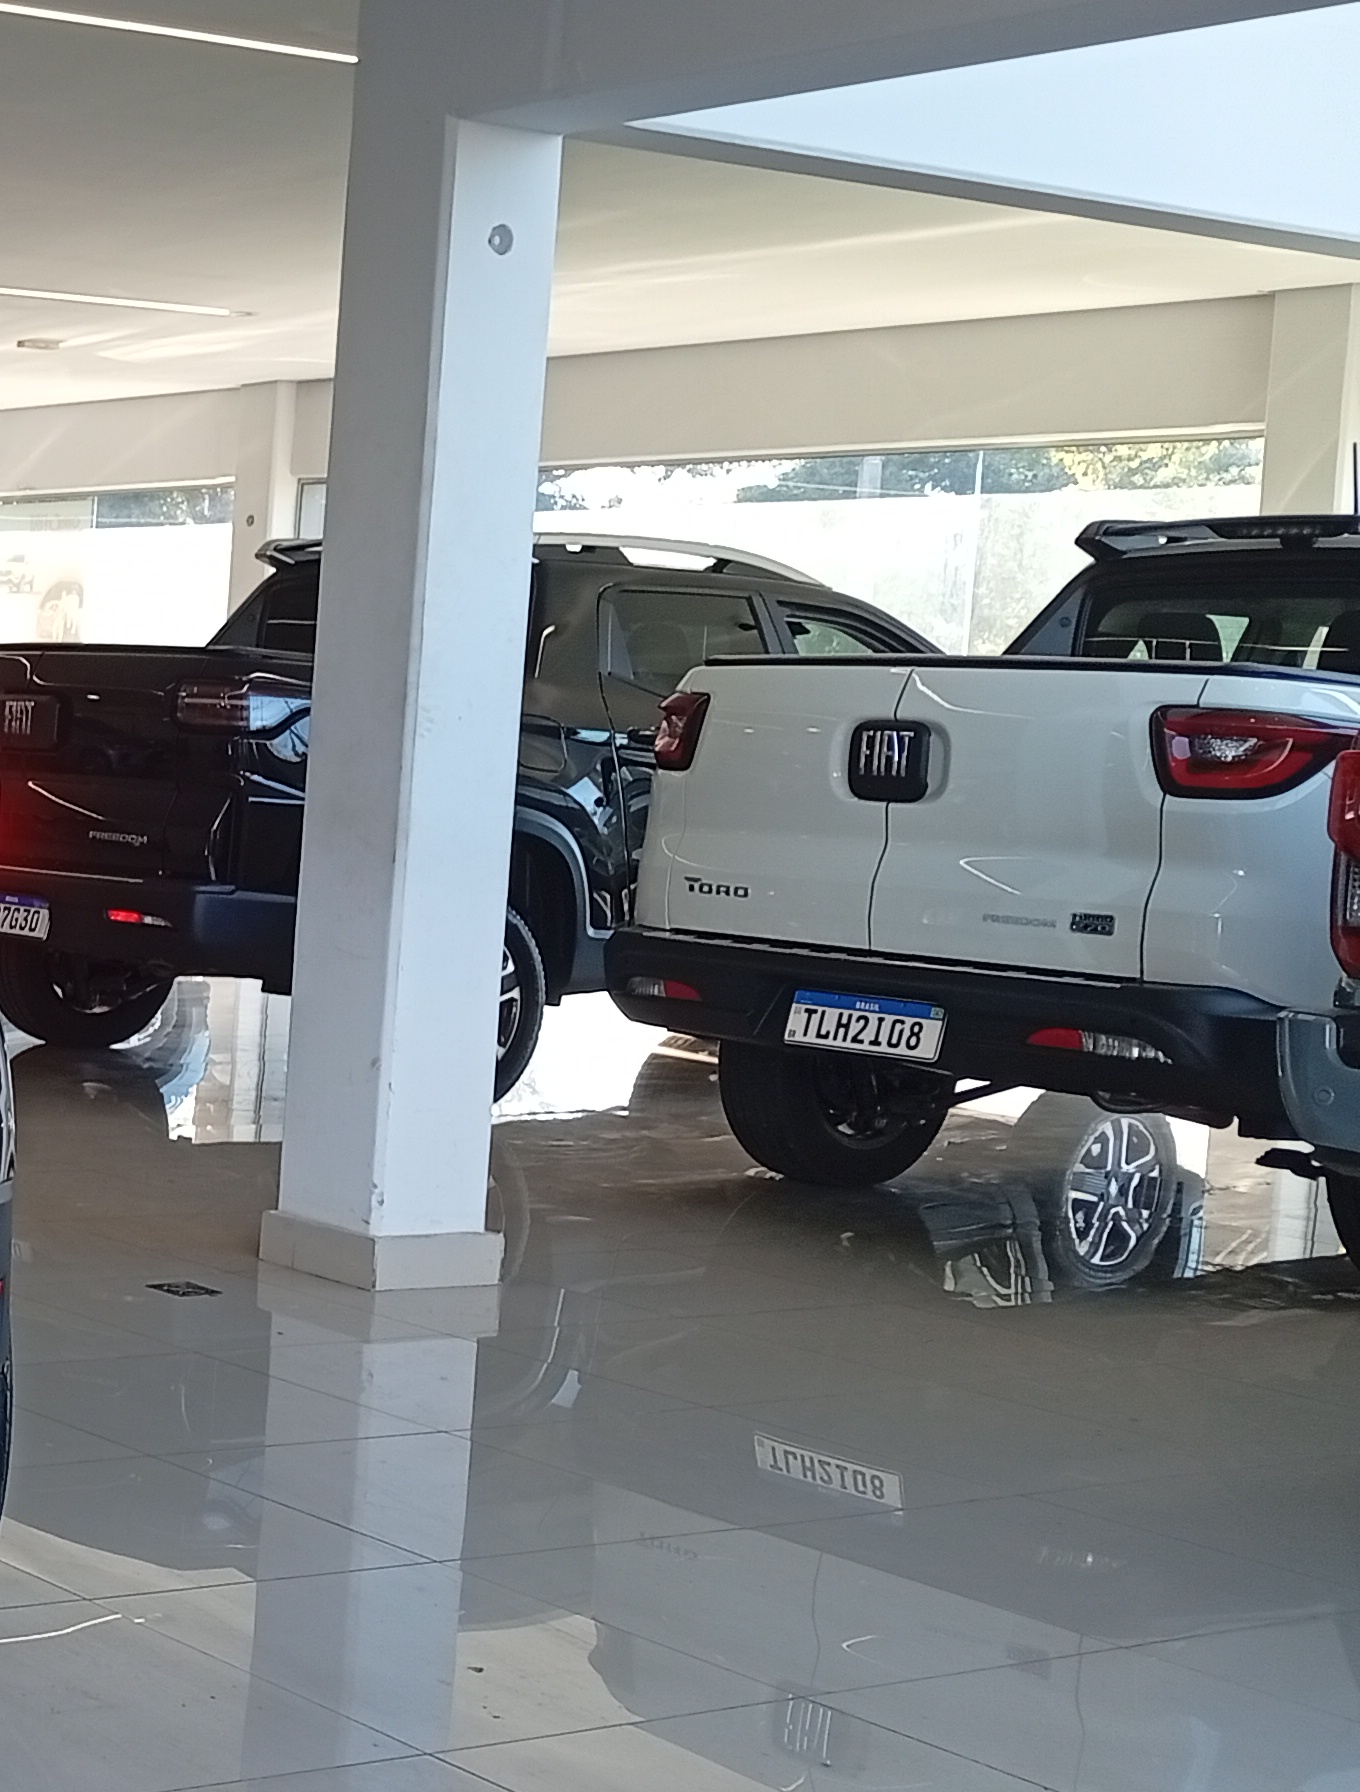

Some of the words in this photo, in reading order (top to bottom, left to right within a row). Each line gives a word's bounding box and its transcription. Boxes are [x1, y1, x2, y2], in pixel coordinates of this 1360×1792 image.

[4, 701, 35, 735] FIAT
[859, 730, 915, 777] FIAT
[684, 876, 749, 898] TORO
[855, 1001, 880, 1012] BRASIL
[802, 1007, 924, 1051] TLH2I08
